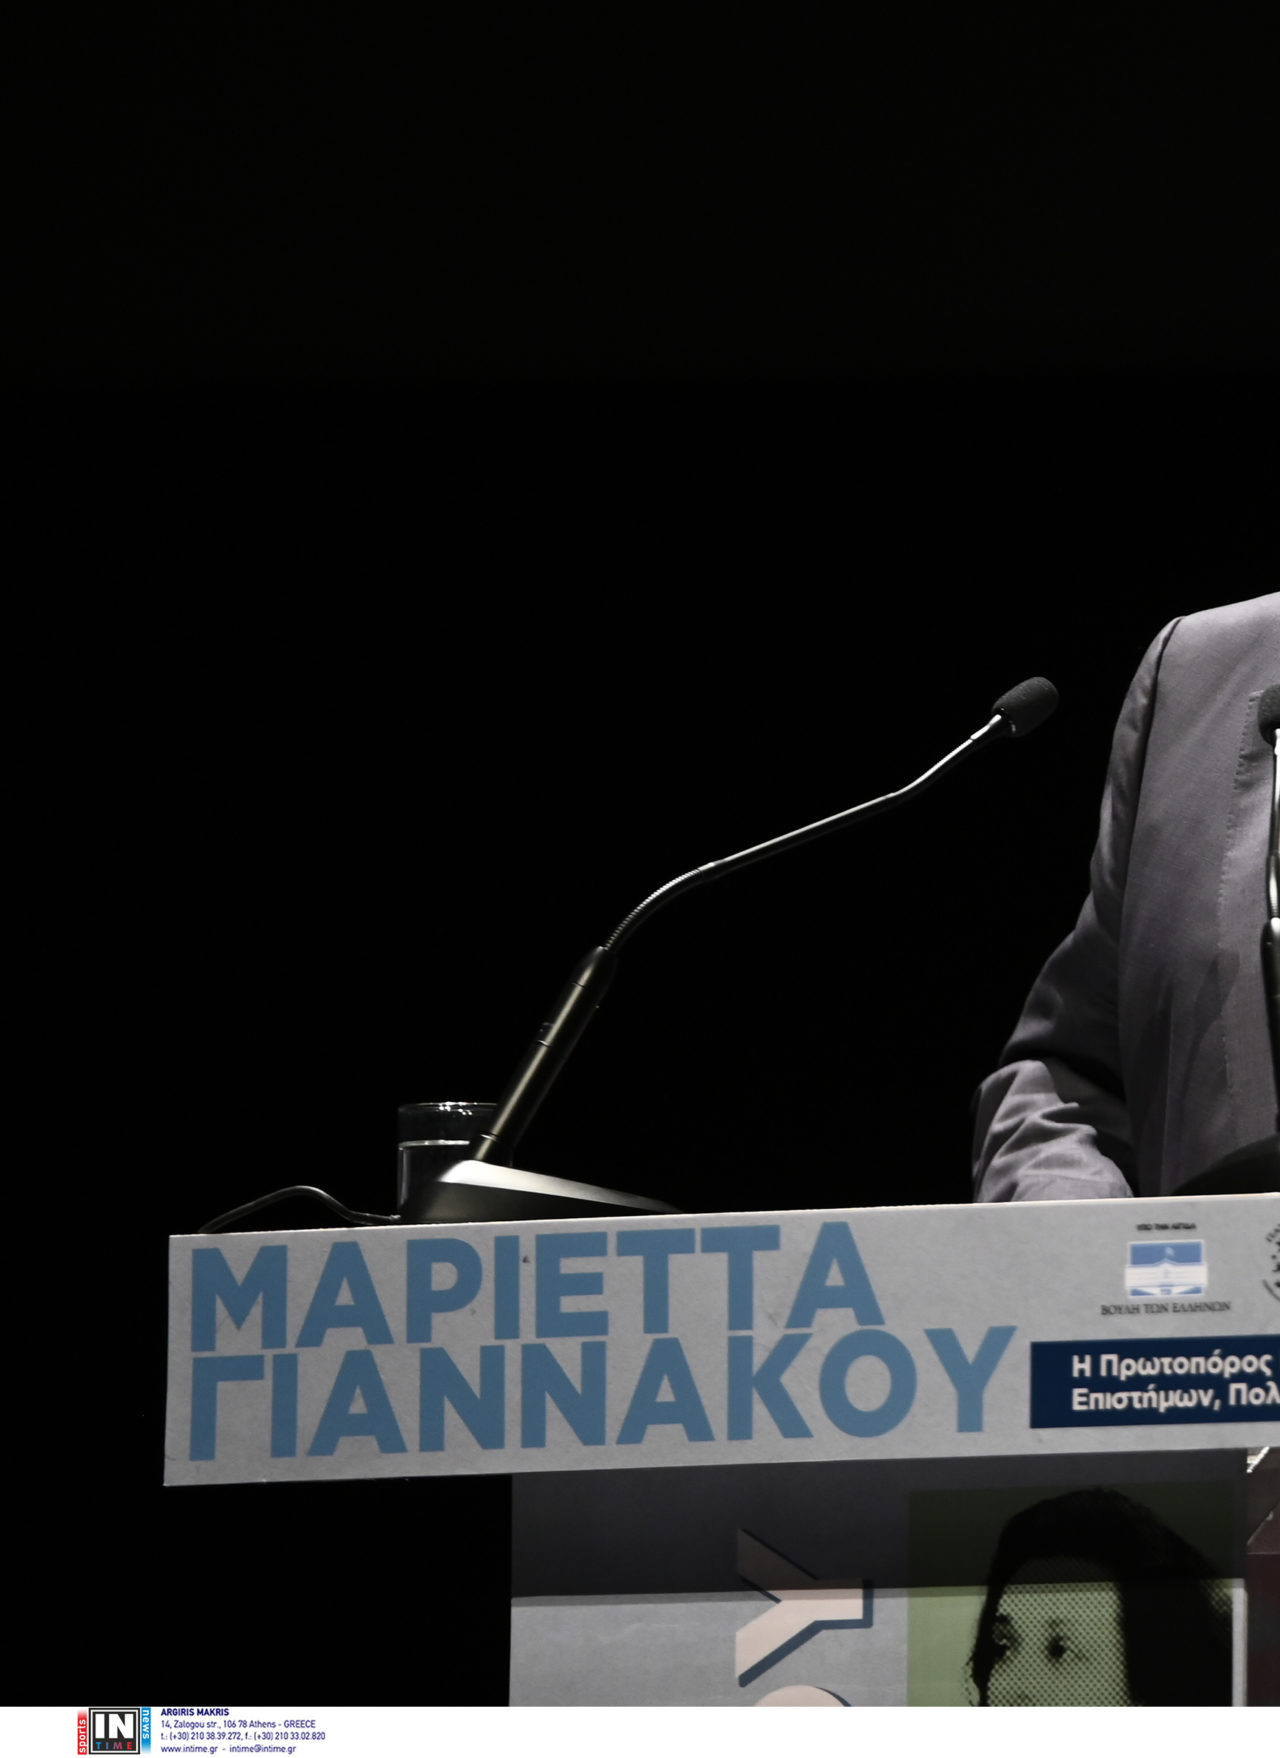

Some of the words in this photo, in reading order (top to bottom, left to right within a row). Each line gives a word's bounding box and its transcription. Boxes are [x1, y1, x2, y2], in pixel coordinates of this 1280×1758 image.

[191, 1221, 886, 1352] ΜΑΡΙΕΤΤΑ
[1101, 1304, 1140, 1315] ΒΟΥΛΗ
[1144, 1303, 1169, 1314] ΤΩΝ
[1172, 1301, 1232, 1313] ΕΛΛΗΝΩΝ
[1071, 1354, 1092, 1378] Η
[1099, 1349, 1273, 1381] Πρωτοπόρος
[189, 1325, 1017, 1461] ΓΙΑΝΝΑΚΟΥ
[1071, 1383, 1221, 1413] Επιστήμων,
